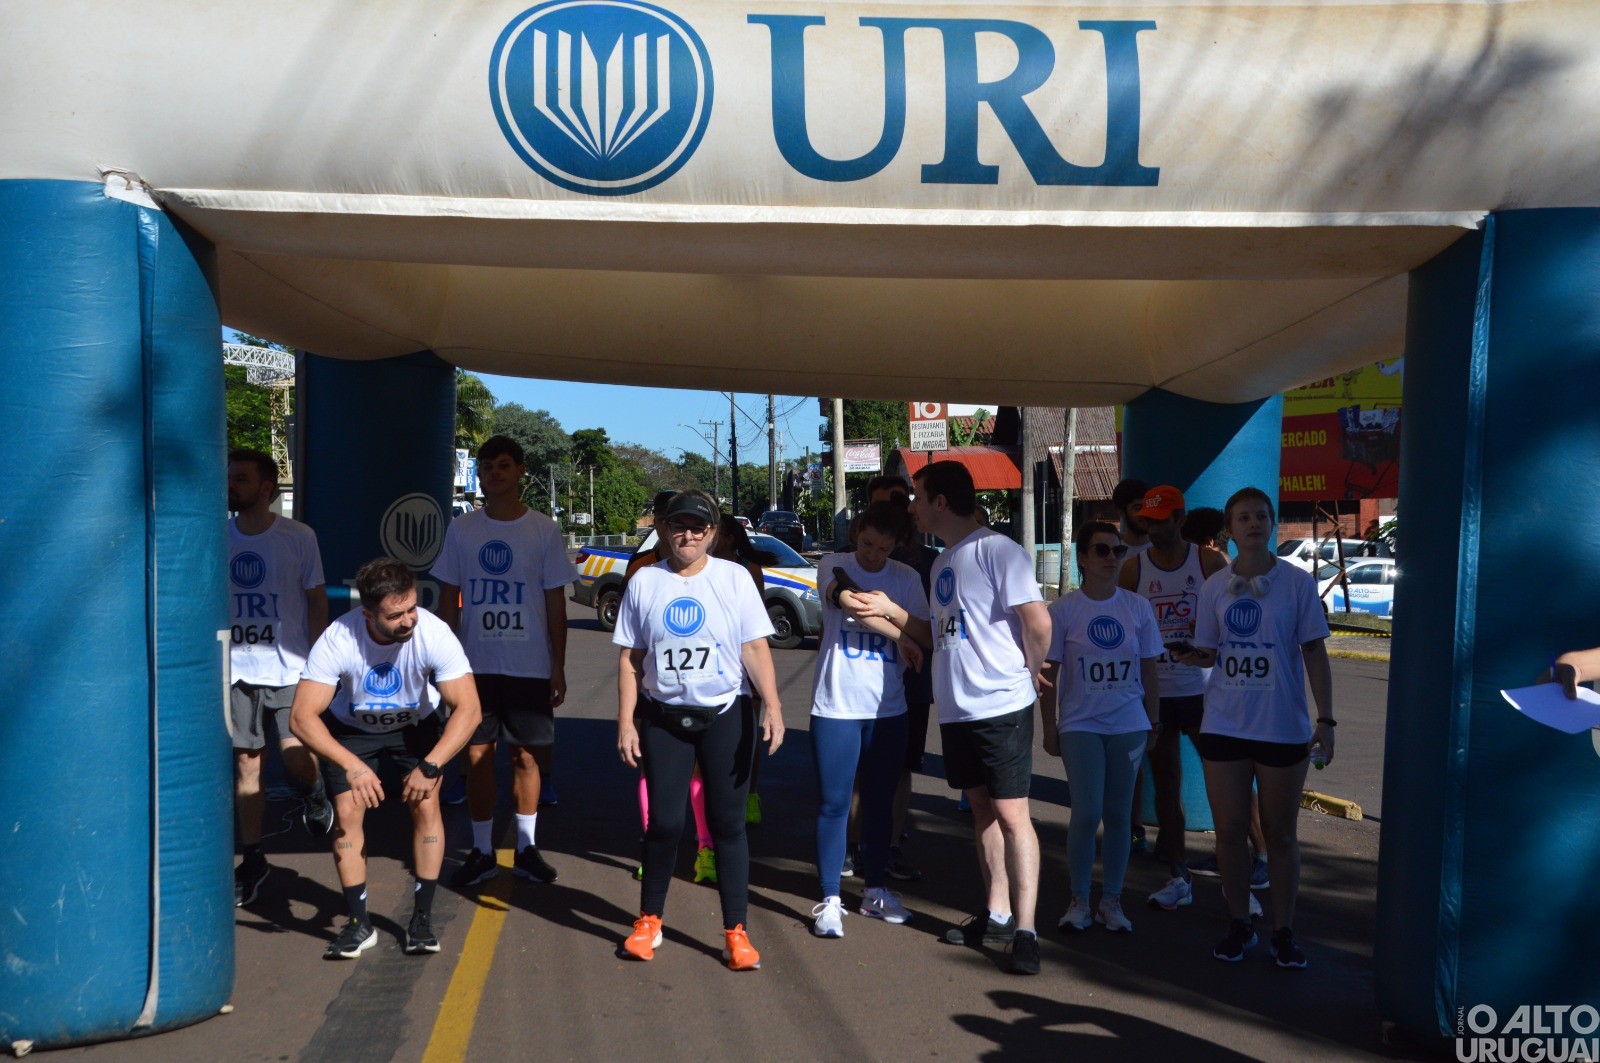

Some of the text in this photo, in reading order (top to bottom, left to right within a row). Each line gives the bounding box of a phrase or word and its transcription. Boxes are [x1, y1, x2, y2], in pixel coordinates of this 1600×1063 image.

[747, 13, 1160, 187] URI
[912, 401, 941, 419] 10
[911, 422, 945, 430] RESTAURANTE
[918, 430, 945, 438] PIZZARIA
[912, 441, 921, 450] DO
[469, 578, 526, 606] URI
[482, 610, 524, 631] 001
[1155, 600, 1191, 620] TAG
[231, 624, 275, 645] 064
[663, 647, 711, 671] 127
[1225, 656, 1270, 678] 049
[1090, 660, 1131, 682] 017
[362, 711, 412, 725] 068
